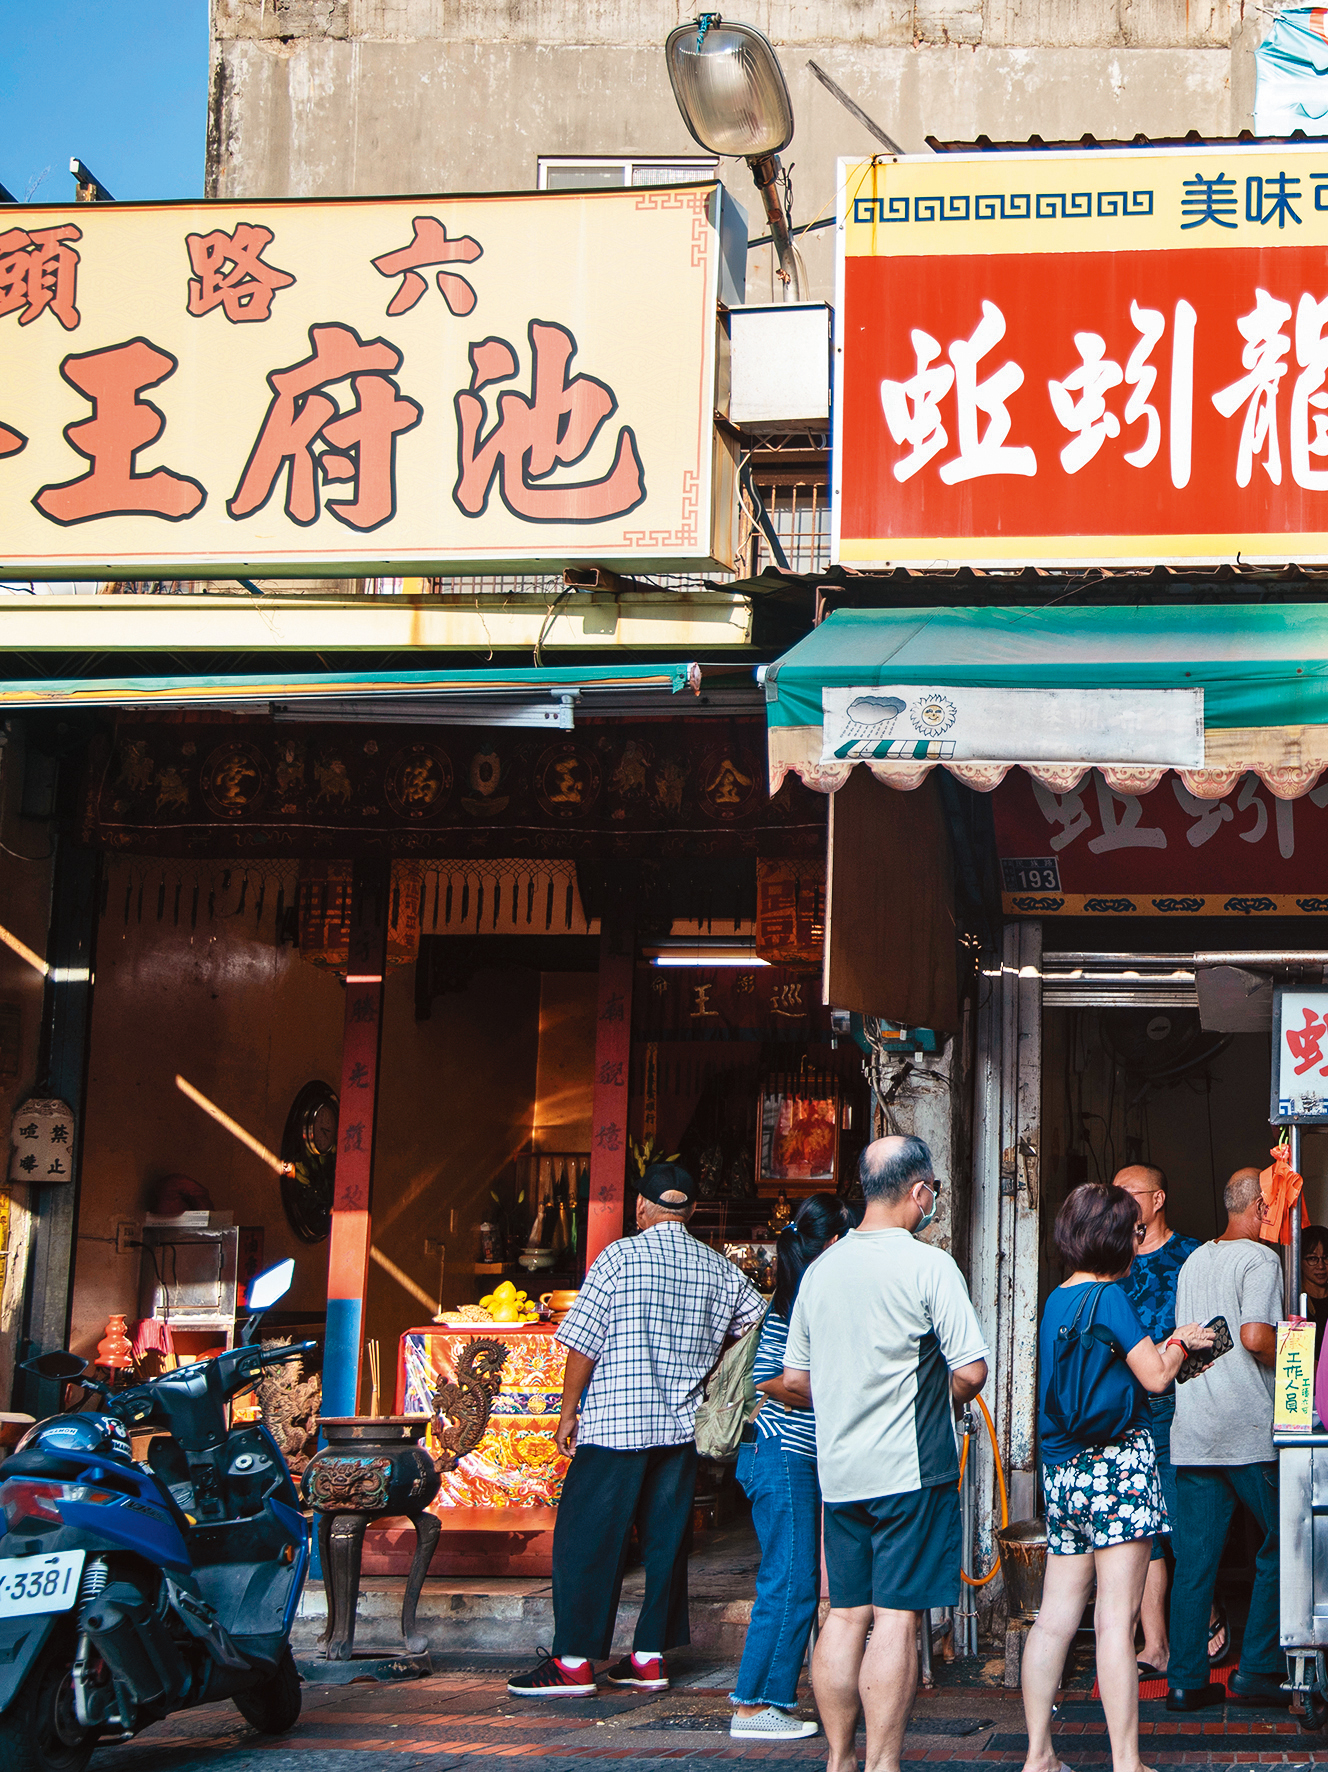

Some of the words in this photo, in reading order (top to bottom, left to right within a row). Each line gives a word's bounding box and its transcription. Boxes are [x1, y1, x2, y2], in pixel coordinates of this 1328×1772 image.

[0, 318, 646, 532] 池府王
[1018, 869, 1056, 889] 193
